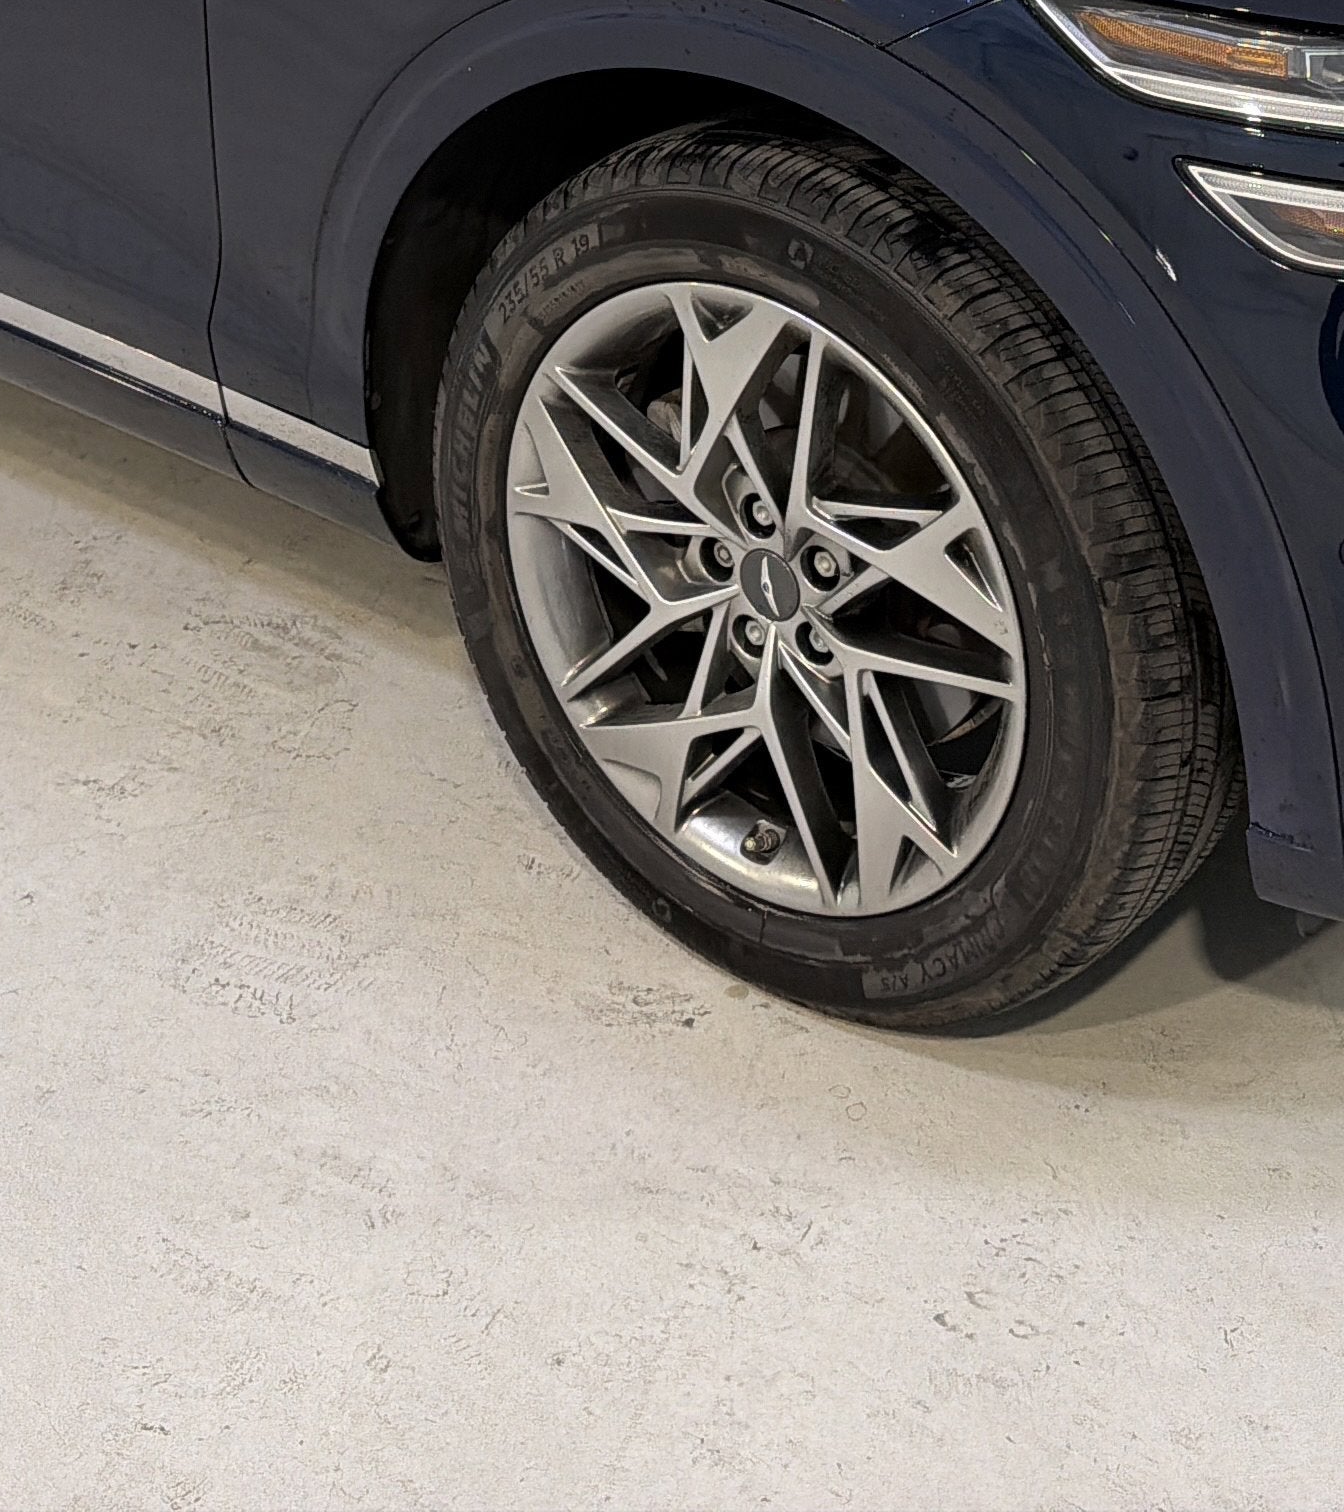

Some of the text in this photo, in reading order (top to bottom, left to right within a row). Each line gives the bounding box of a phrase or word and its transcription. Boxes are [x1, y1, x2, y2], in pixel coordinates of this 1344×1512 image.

[498, 259, 549, 322] 235/55
[554, 248, 567, 267] R
[571, 235, 590, 257] 19
[452, 342, 491, 534] MICHELIN
